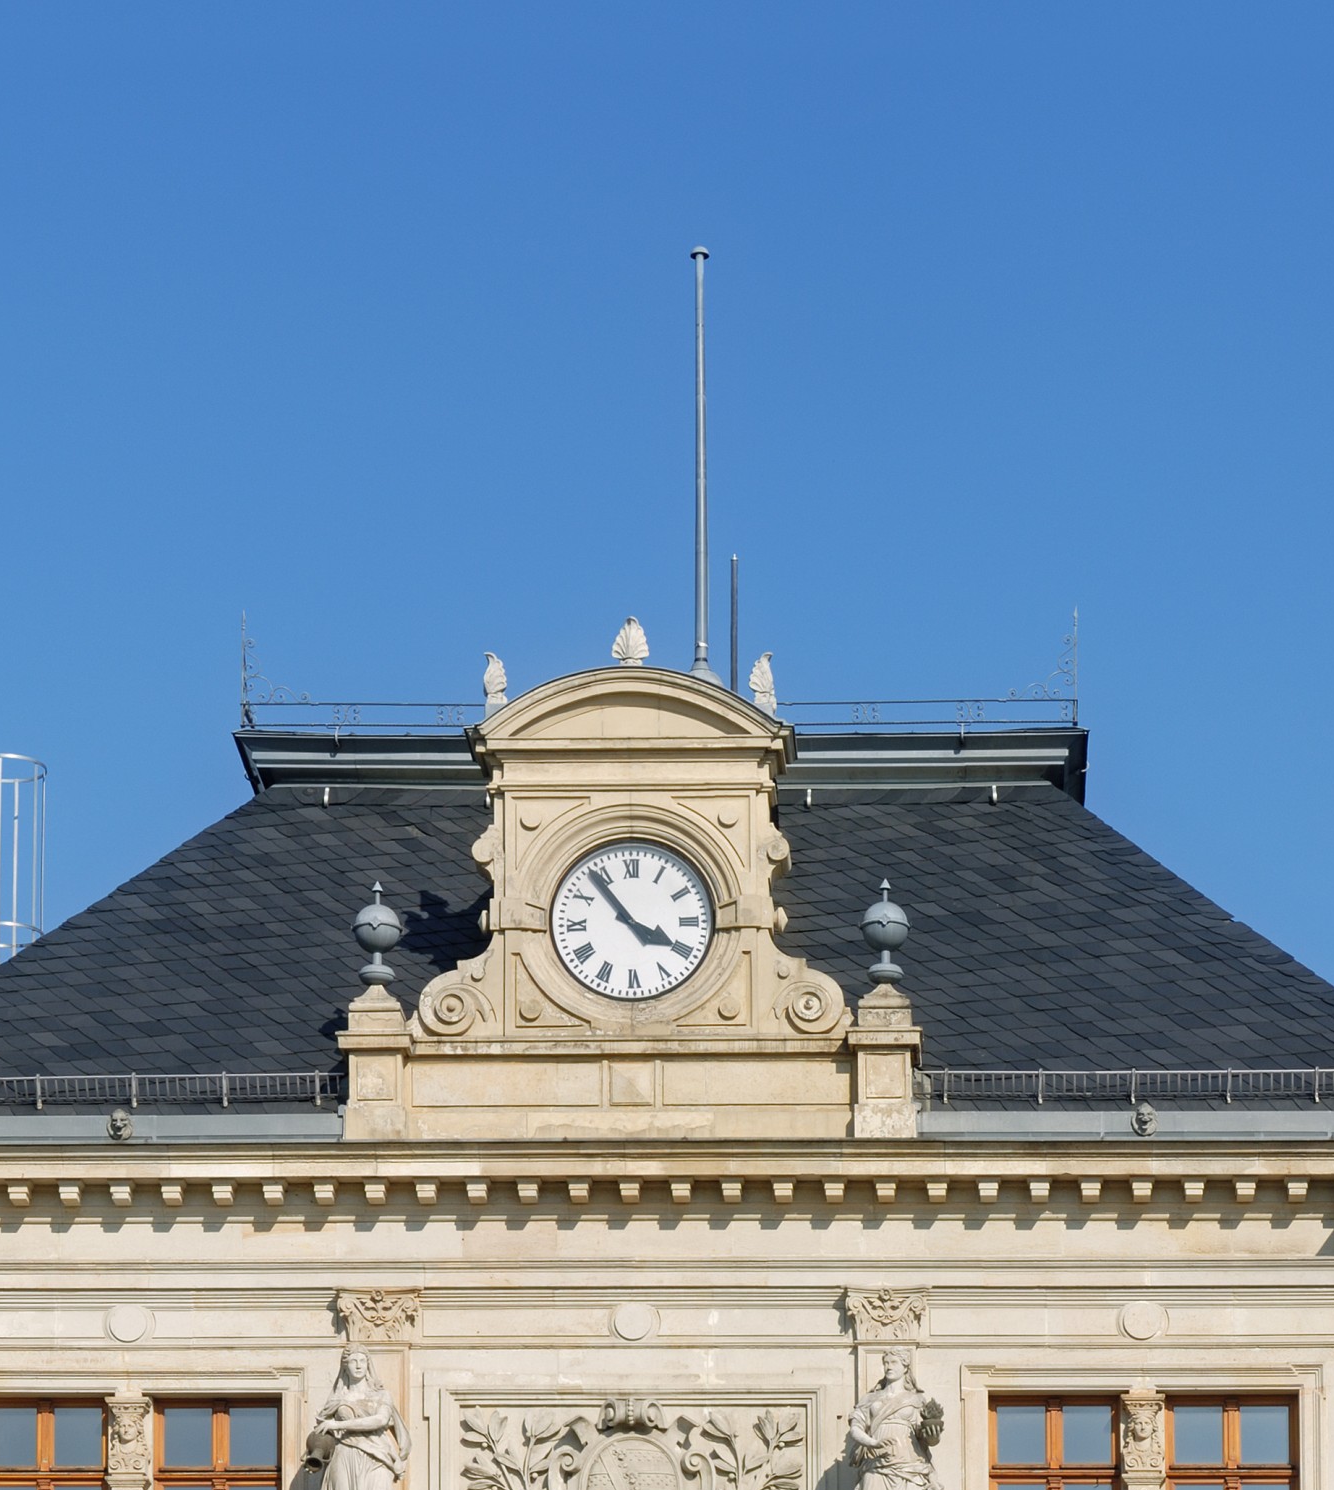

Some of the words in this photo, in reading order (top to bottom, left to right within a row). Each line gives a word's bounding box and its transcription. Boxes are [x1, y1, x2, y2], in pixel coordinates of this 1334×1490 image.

[622, 859, 640, 879] XII
[652, 865, 667, 885] I
[572, 888, 595, 907] X
[670, 885, 692, 902] II
[679, 915, 700, 928] III
[572, 942, 596, 965] VIII
[595, 960, 613, 984] VII
[627, 969, 642, 989] VI
[656, 961, 672, 981] V
